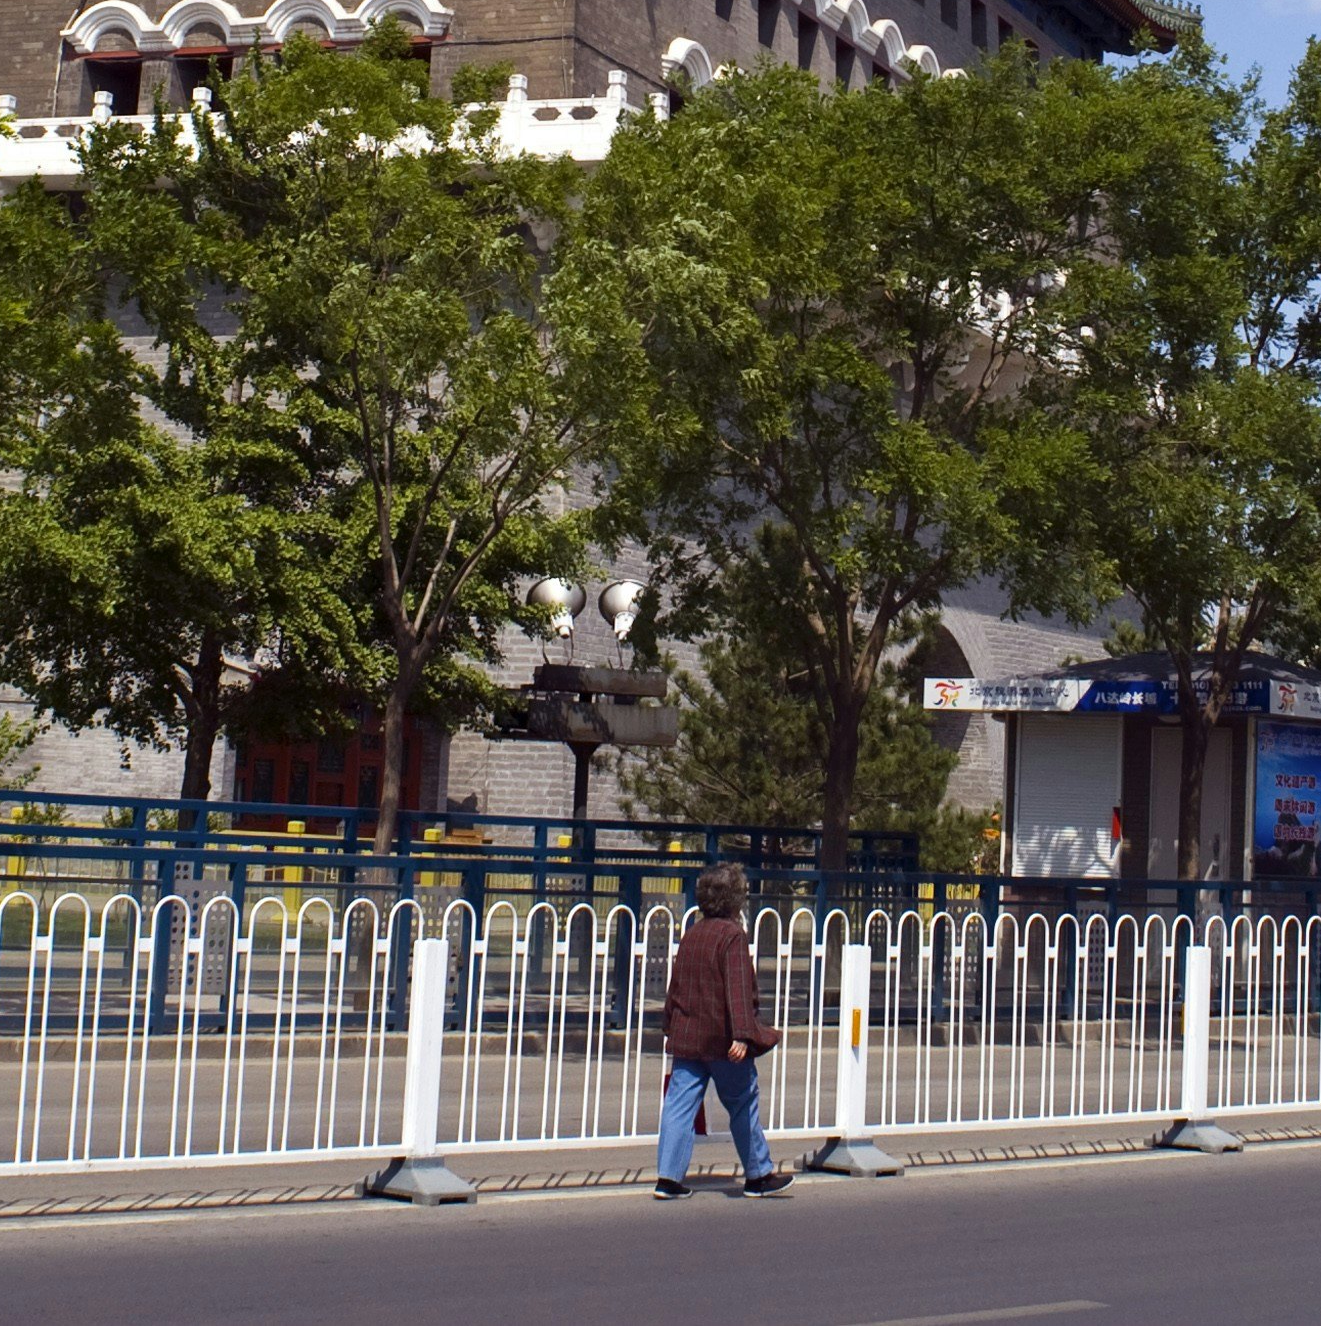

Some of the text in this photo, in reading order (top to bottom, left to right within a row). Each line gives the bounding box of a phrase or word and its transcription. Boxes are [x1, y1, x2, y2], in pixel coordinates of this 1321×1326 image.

[1243, 681, 1262, 689] 1111
[1094, 692, 1157, 704] 八达岭长城
